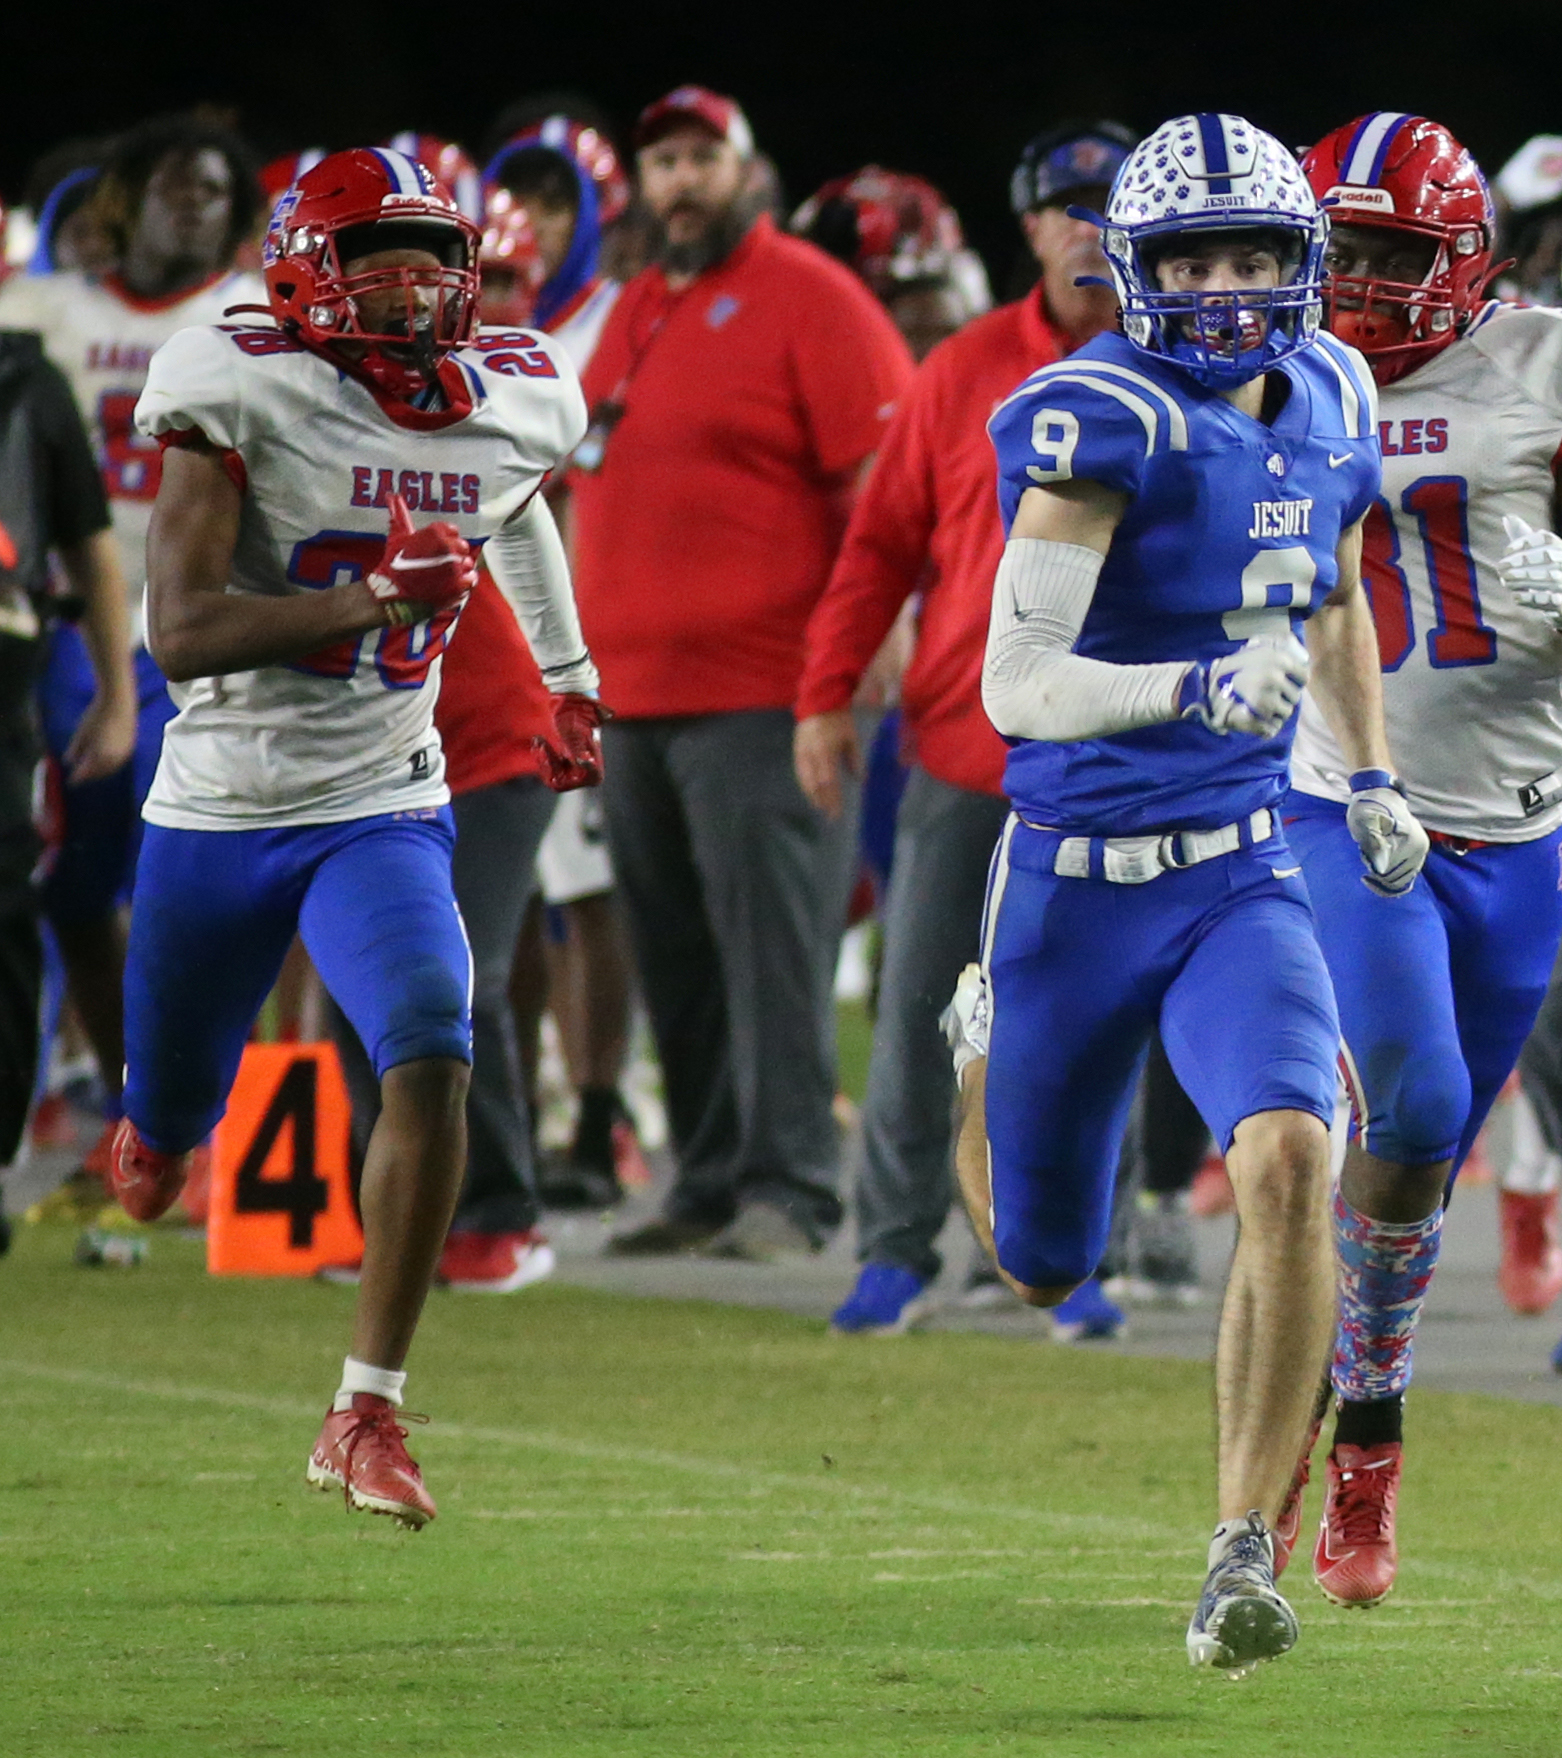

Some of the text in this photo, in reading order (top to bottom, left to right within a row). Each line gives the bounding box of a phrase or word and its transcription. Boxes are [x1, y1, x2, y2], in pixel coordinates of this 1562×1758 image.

[1202, 195, 1246, 208] JESUIT
[1026, 408, 1080, 483] 9
[1378, 418, 1449, 457] LES
[350, 466, 480, 514] EAGLES
[1248, 499, 1314, 539] JESUIT
[235, 1058, 346, 1249] 4
